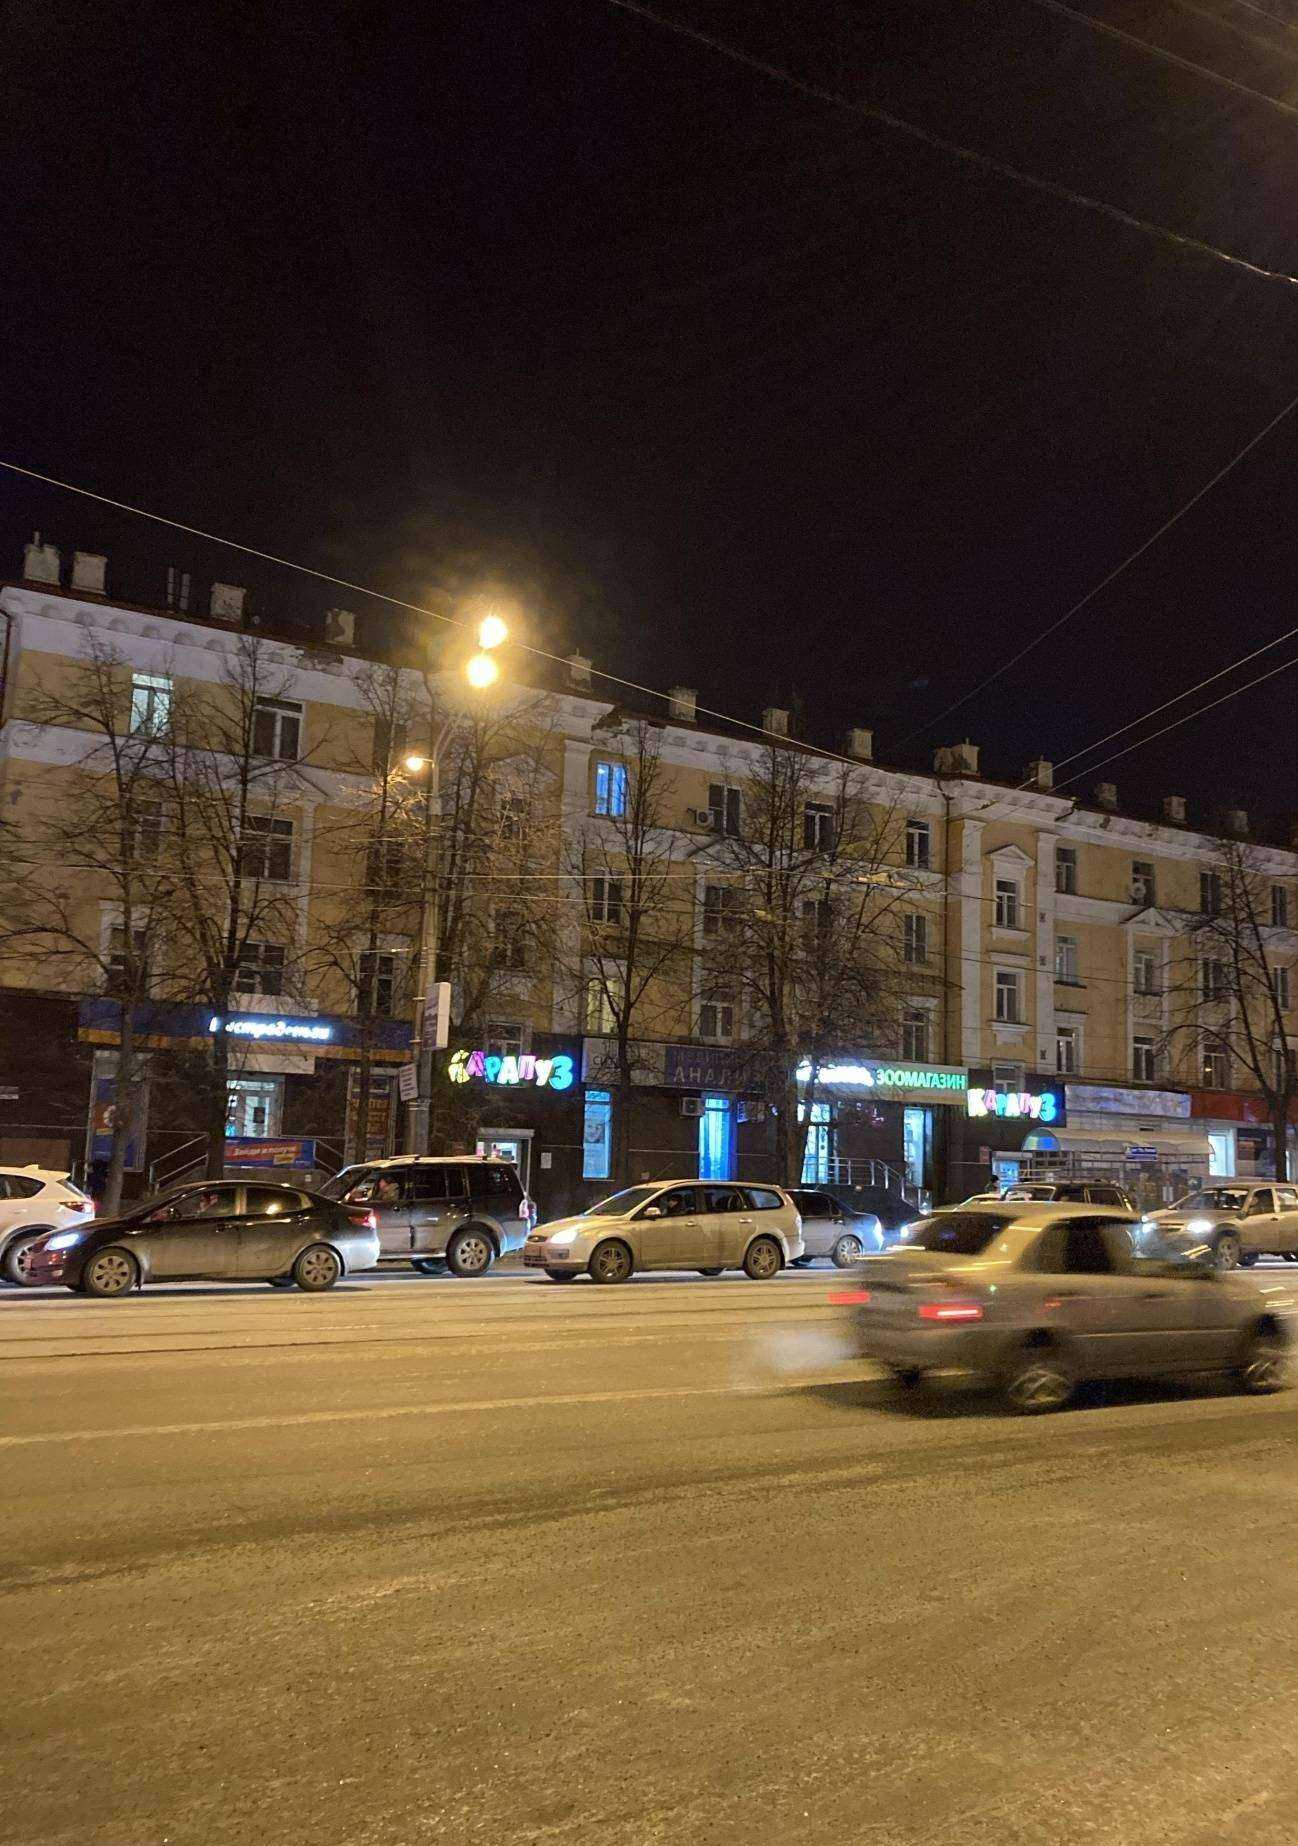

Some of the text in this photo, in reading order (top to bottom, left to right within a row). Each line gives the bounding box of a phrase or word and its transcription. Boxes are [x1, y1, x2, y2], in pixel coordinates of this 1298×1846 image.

[448, 1049, 574, 1091] КАРАПУЗ
[875, 1069, 966, 1090] ЗООМАГАЗИН
[966, 1088, 1057, 1122] КАРАПУЗ
